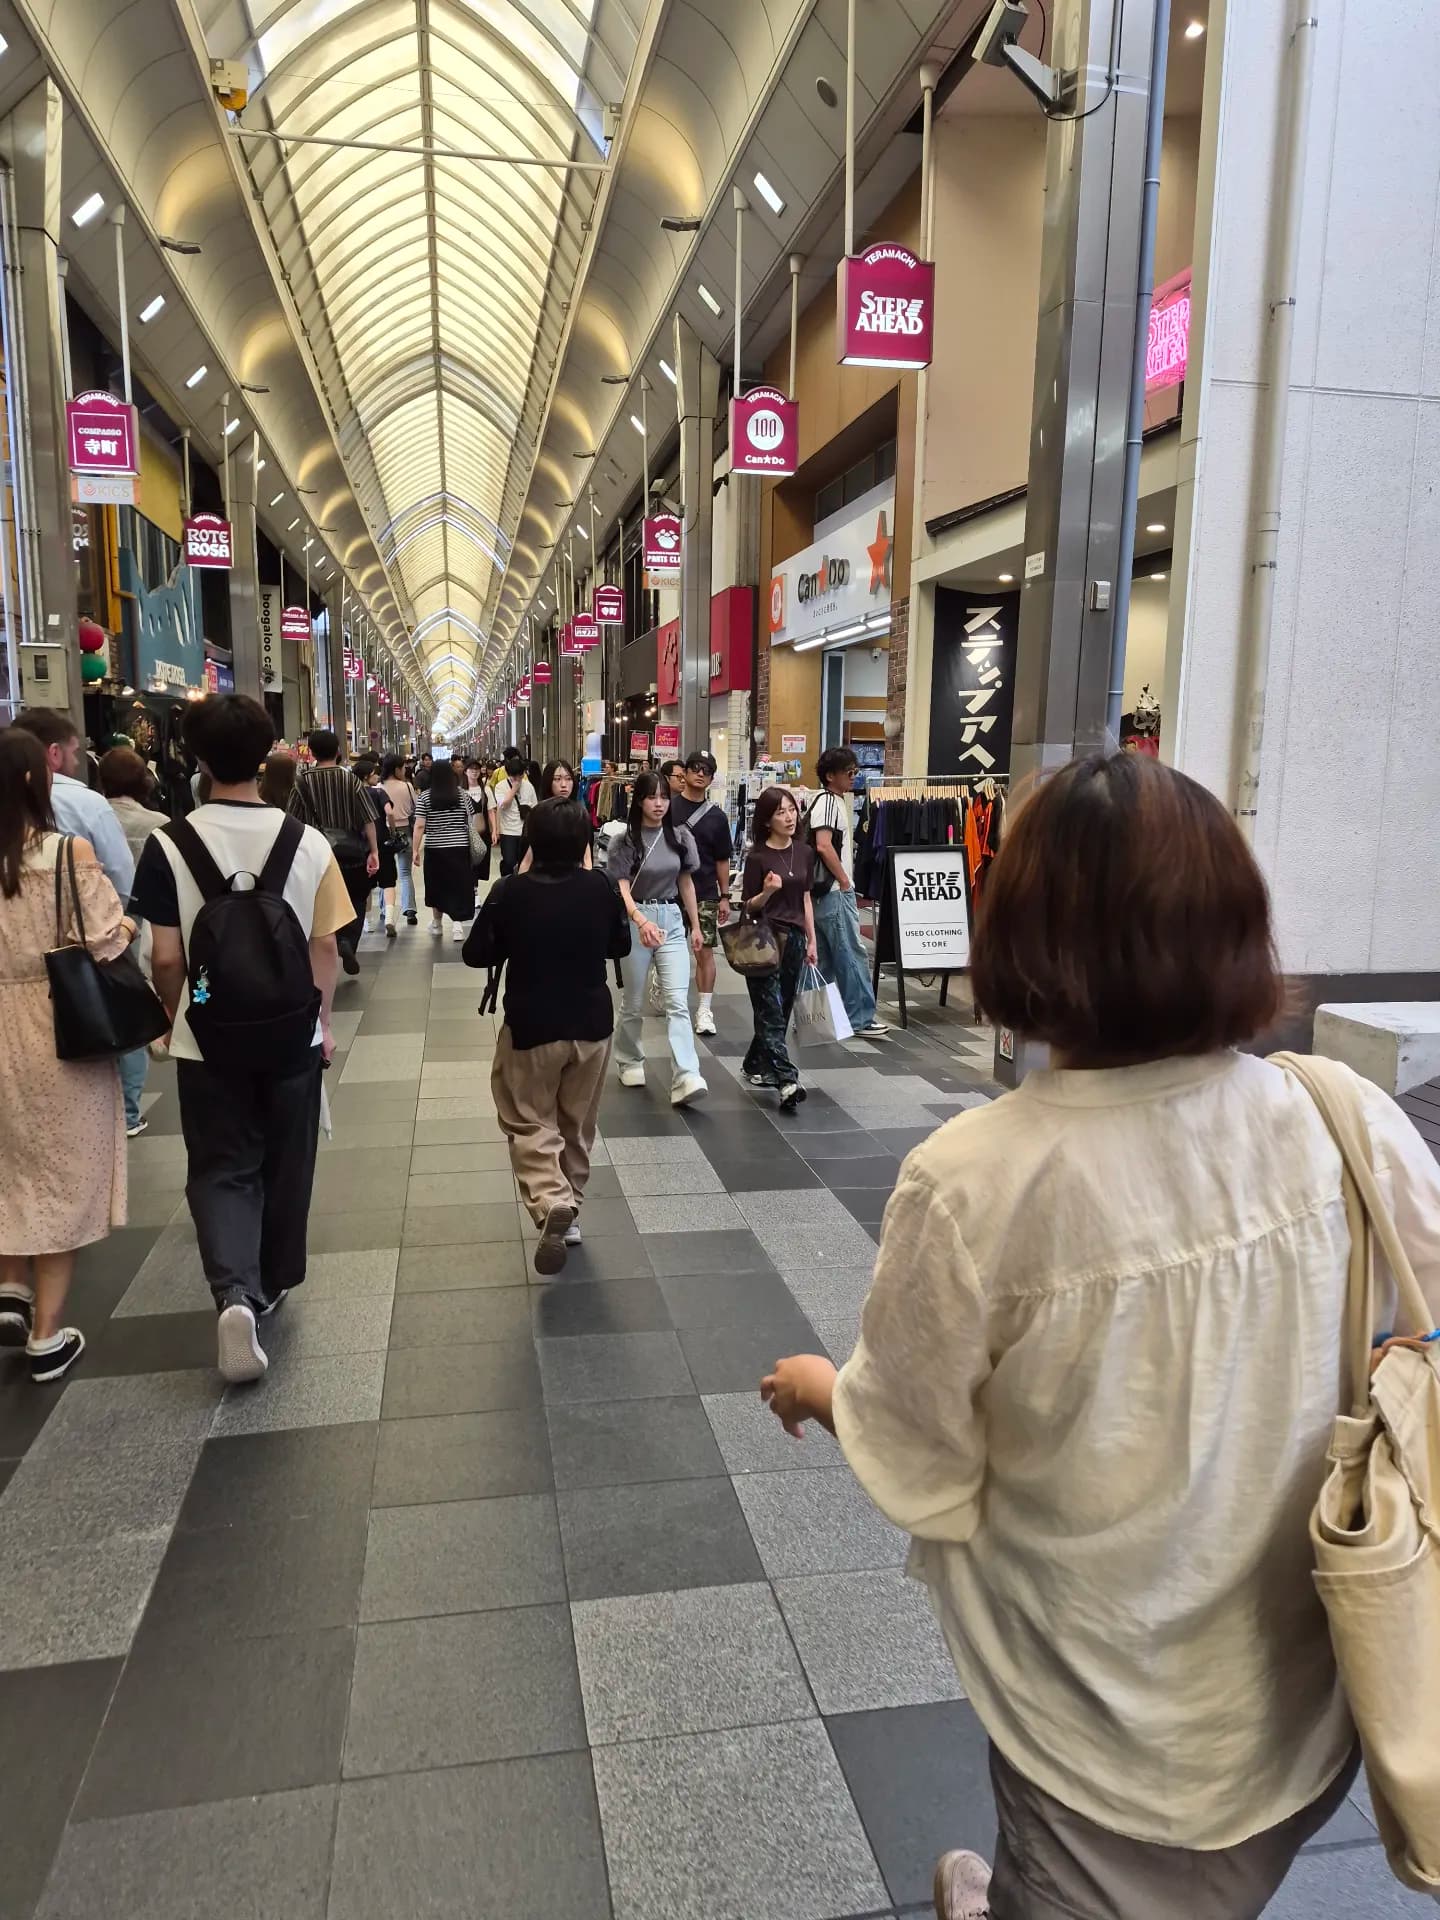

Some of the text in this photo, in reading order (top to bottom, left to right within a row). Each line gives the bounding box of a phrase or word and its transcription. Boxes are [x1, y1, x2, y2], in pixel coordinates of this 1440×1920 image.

[865, 249, 917, 269] TERAMACHI
[860, 290, 909, 316] STEP
[854, 312, 924, 335] AHEAD
[77, 392, 119, 407] TERAMACHI
[746, 391, 786, 406] TERAMACHI
[754, 418, 777, 438] 100
[84, 438, 118, 456] 寺町
[187, 528, 229, 544] ROTE
[188, 541, 230, 558] ROSA
[261, 593, 273, 652] boogaloo
[903, 868, 946, 887] STEP
[900, 885, 962, 902] AHEAD
[925, 929, 963, 937] CLOTHING
[921, 940, 948, 948] STORE
